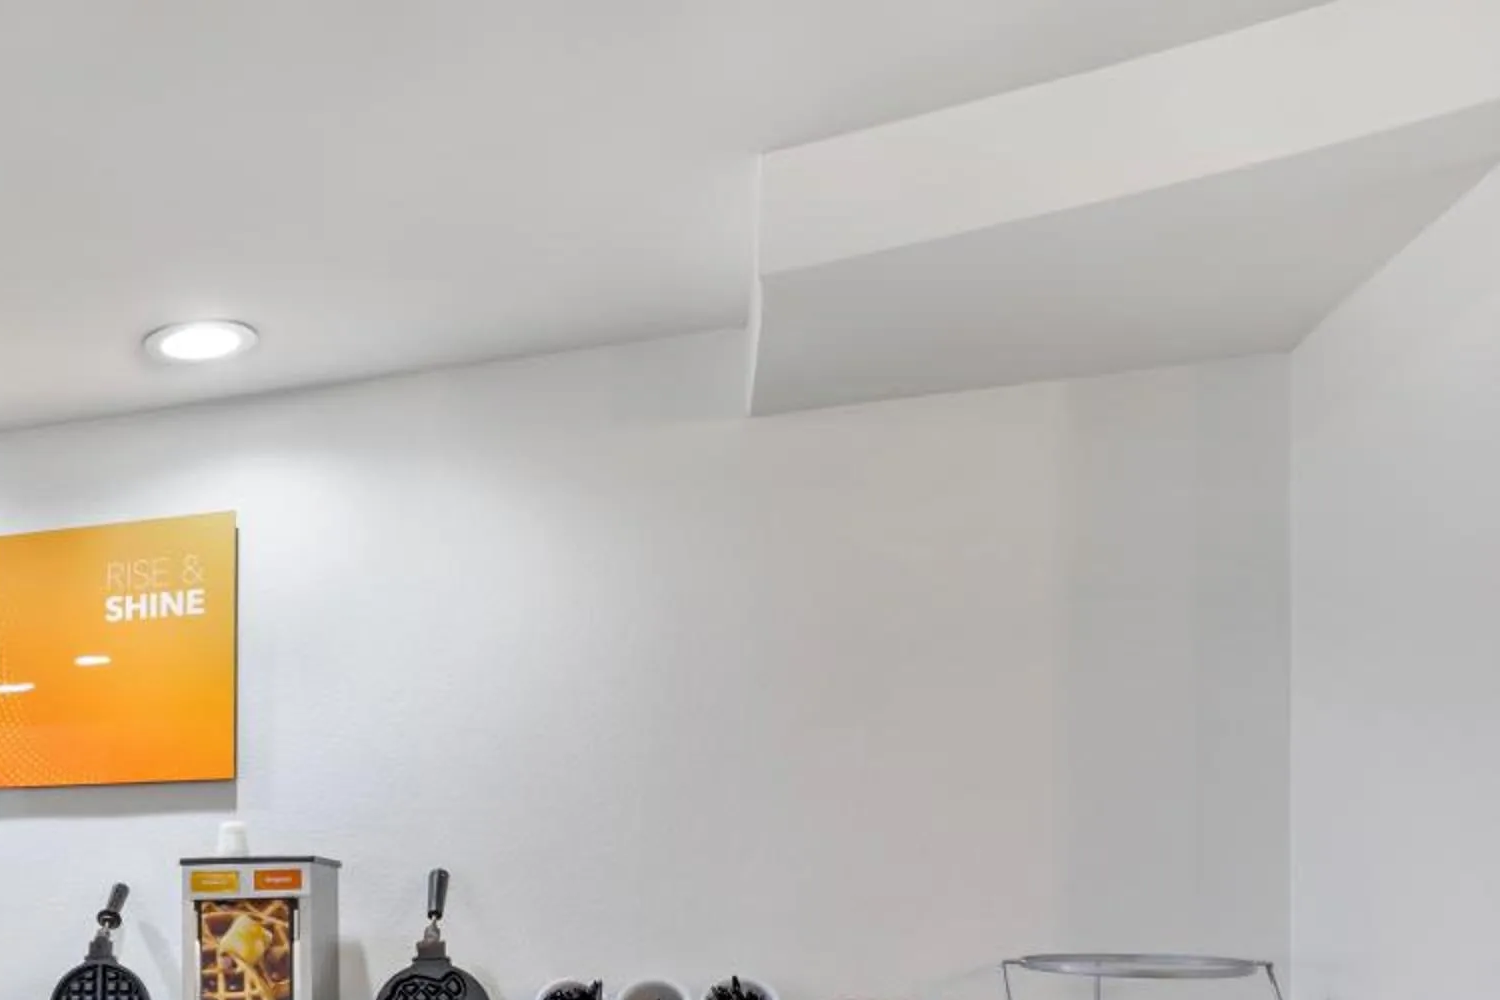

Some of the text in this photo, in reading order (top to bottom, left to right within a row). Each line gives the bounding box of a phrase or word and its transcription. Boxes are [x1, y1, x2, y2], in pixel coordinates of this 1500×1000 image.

[106, 553, 204, 592] RISE &
[105, 589, 205, 622] SHINE
